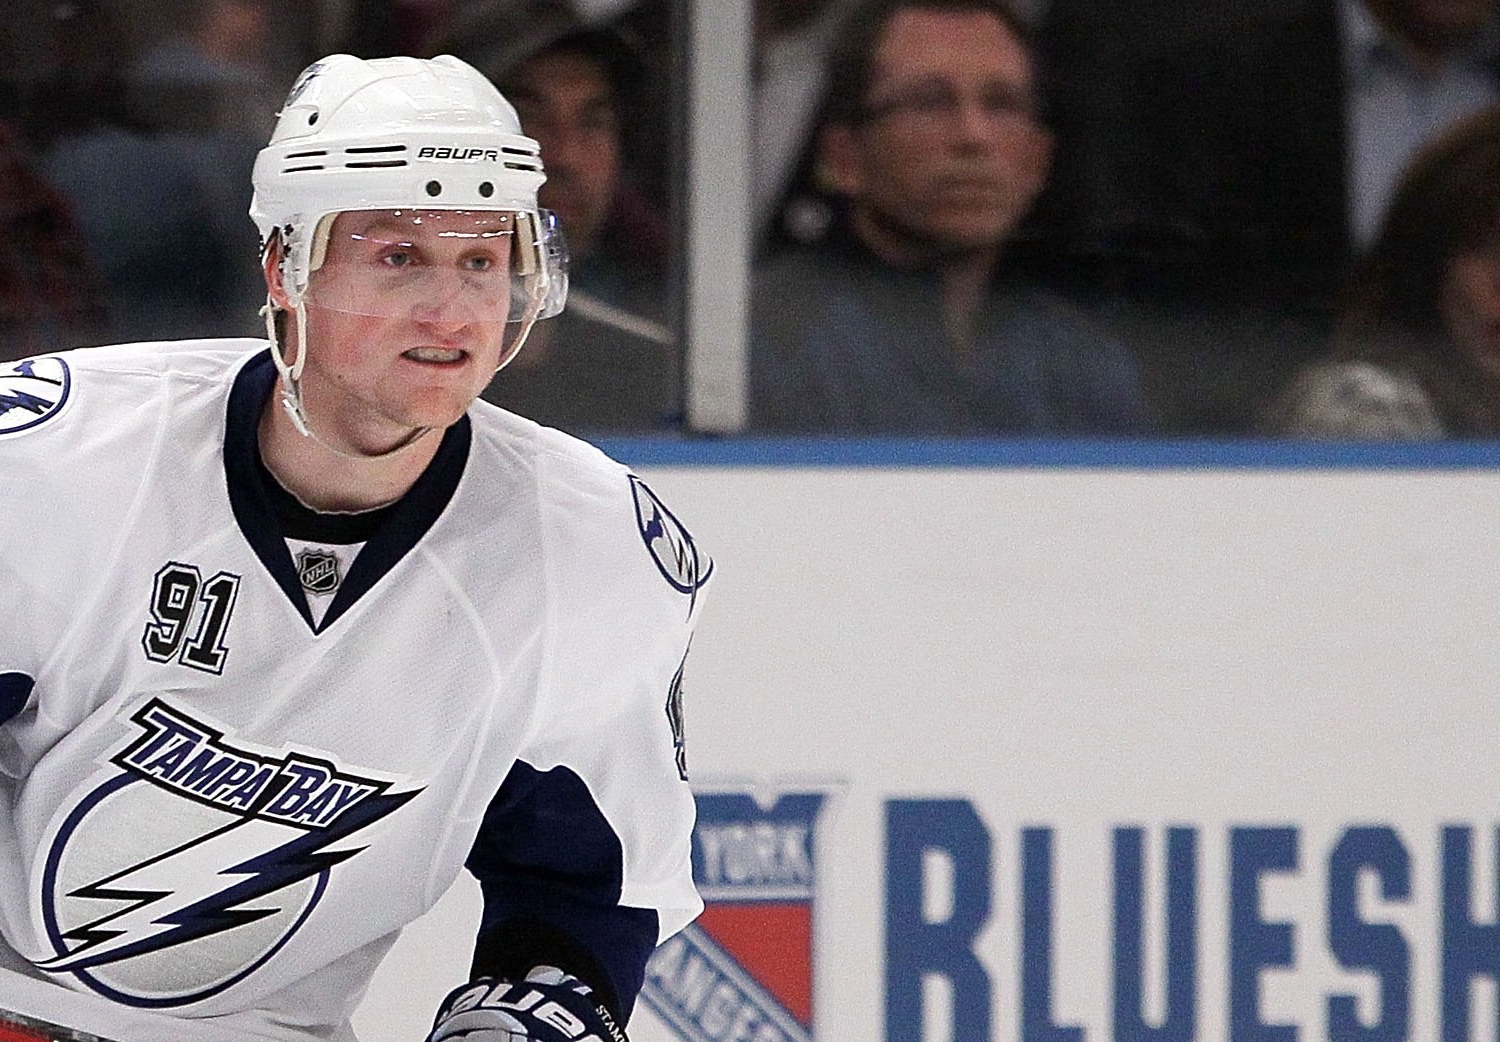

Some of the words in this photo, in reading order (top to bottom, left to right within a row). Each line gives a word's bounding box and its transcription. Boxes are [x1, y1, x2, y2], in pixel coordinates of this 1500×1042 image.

[143, 561, 242, 675] 91
[126, 702, 280, 812] TAMPA
[260, 758, 380, 829] BAY
